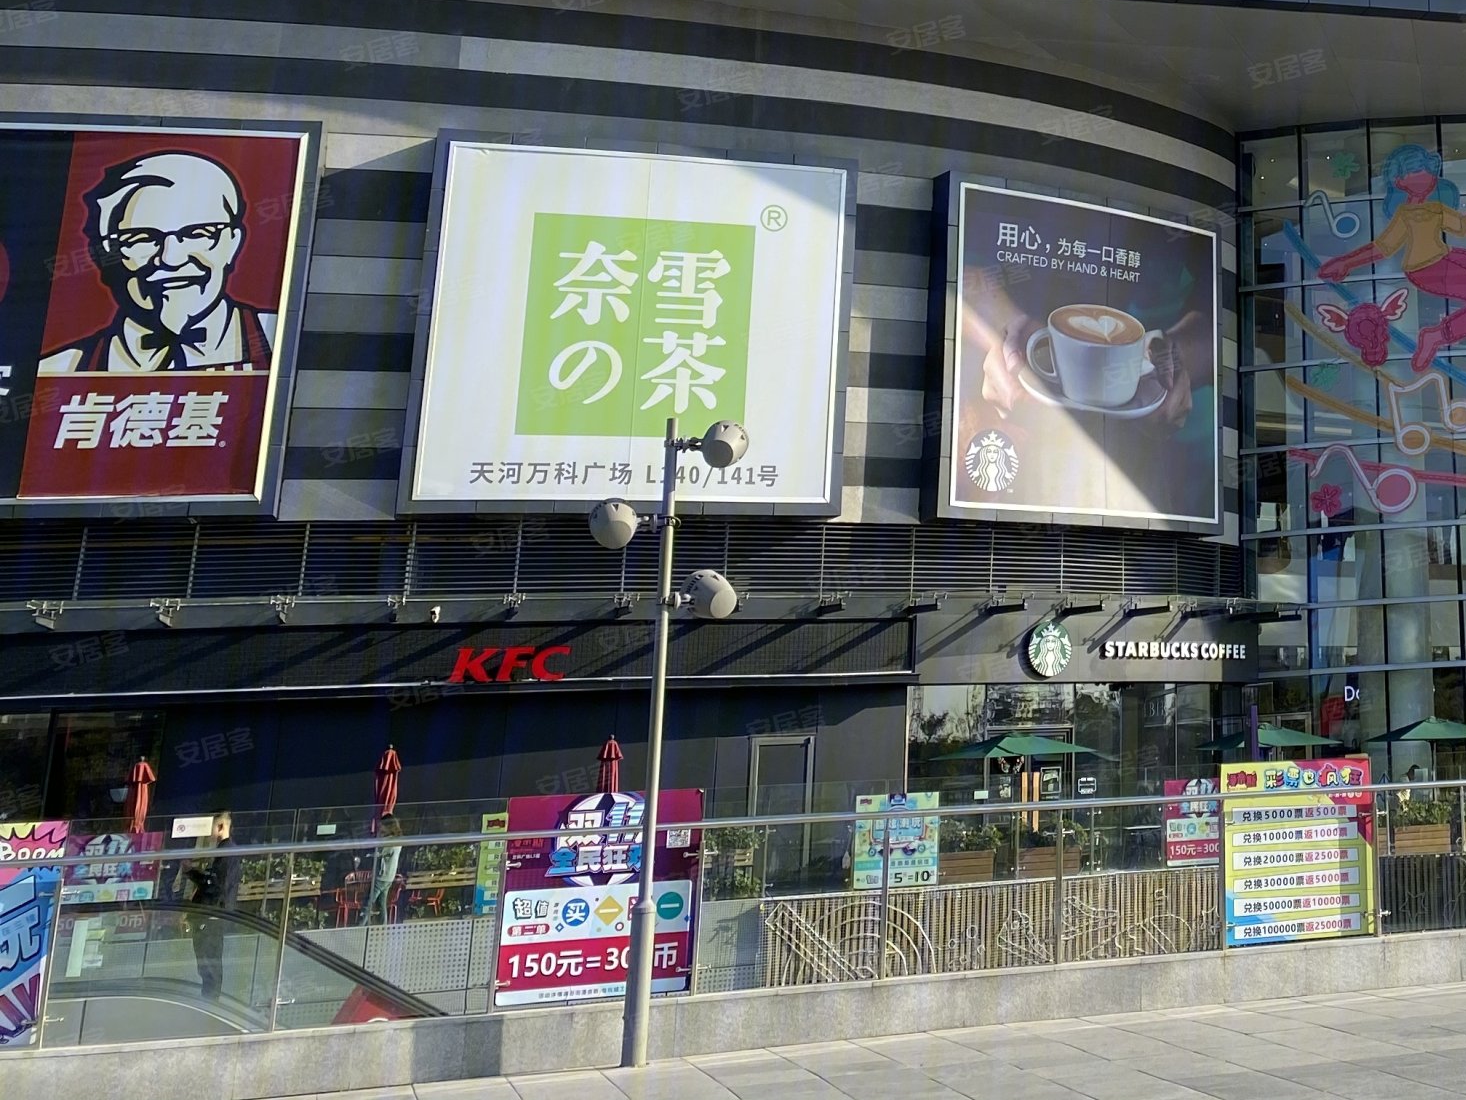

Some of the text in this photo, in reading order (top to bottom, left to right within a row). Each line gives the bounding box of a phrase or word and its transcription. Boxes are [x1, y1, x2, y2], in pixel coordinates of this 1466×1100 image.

[996, 250, 1141, 283] CRAFTED BY HAND & HEART
[550, 241, 731, 329] 奈雪
[548, 331, 726, 414] の茶
[53, 391, 229, 450] 肯德基
[469, 461, 632, 485] 天河万科广场
[448, 644, 572, 683] KFC
[1104, 641, 1246, 660] STARBUCKS COFFEE
[513, 898, 549, 920] 超值
